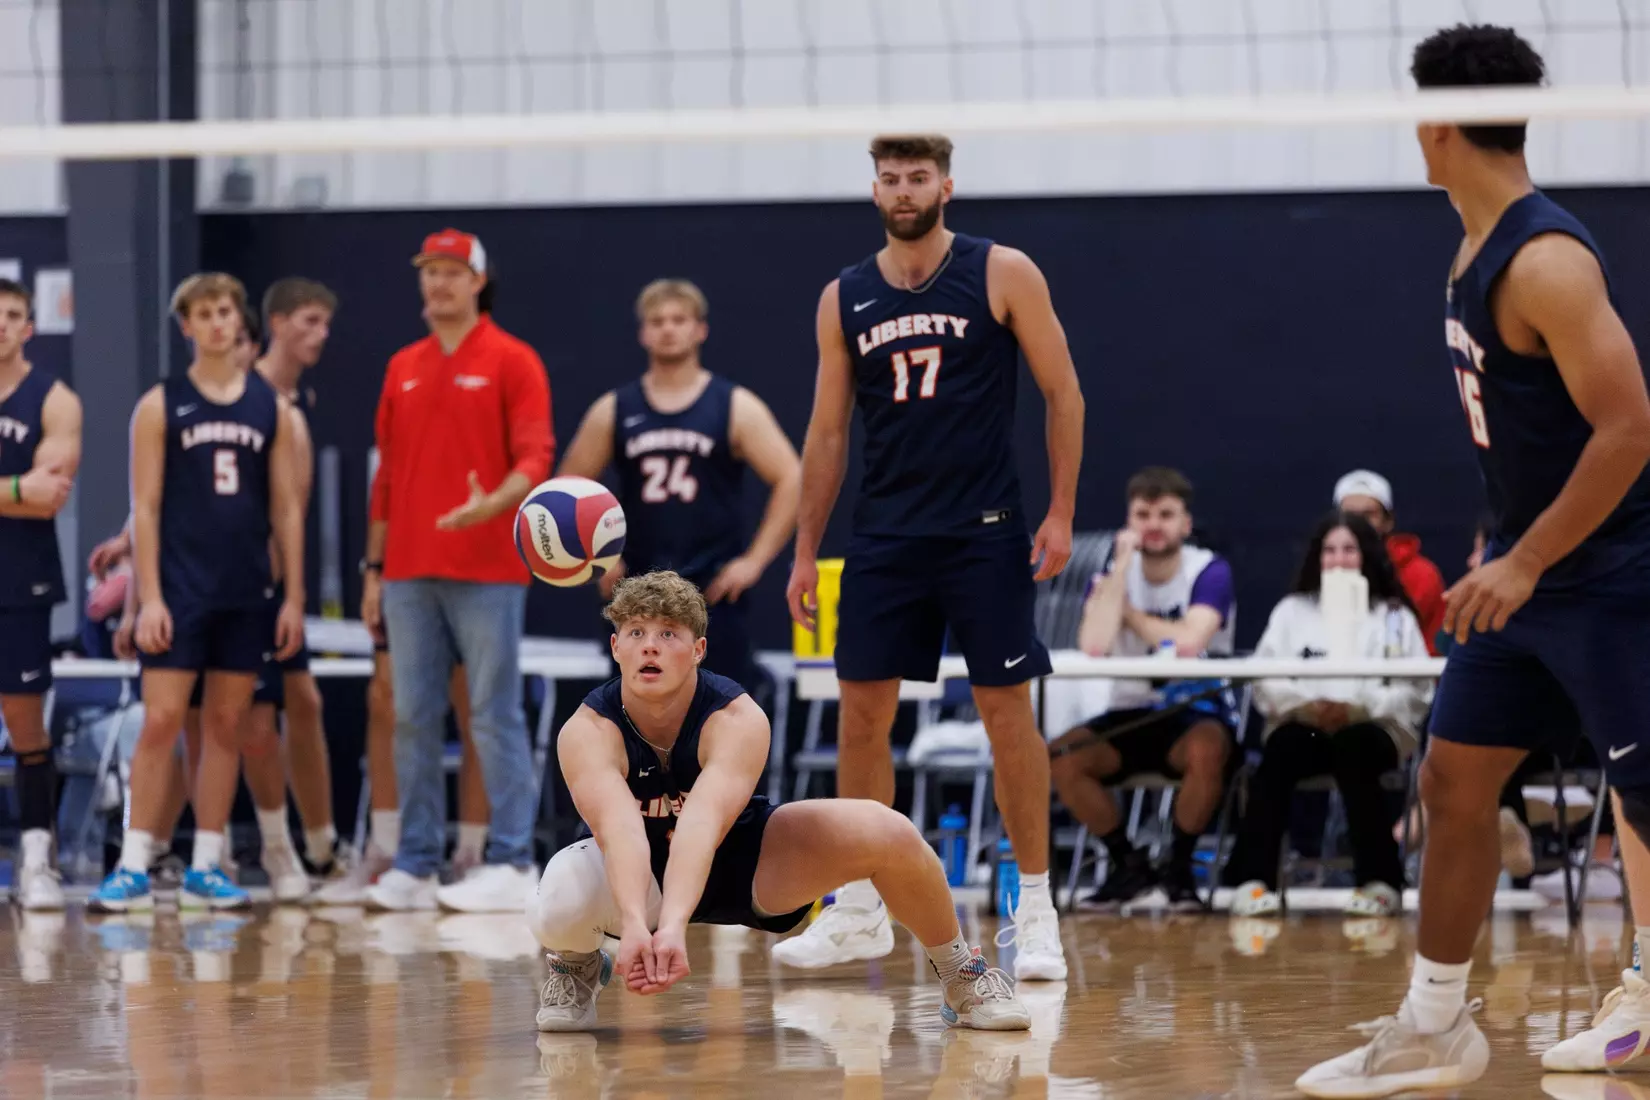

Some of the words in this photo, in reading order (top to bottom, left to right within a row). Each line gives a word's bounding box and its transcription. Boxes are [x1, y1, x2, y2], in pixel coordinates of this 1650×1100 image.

[856, 313, 970, 357] LIBERTY
[1445, 317, 1486, 373] ERTY
[890, 344, 942, 404] 17
[214, 448, 239, 496] 5
[640, 454, 699, 503] 24
[537, 513, 555, 561] molten
